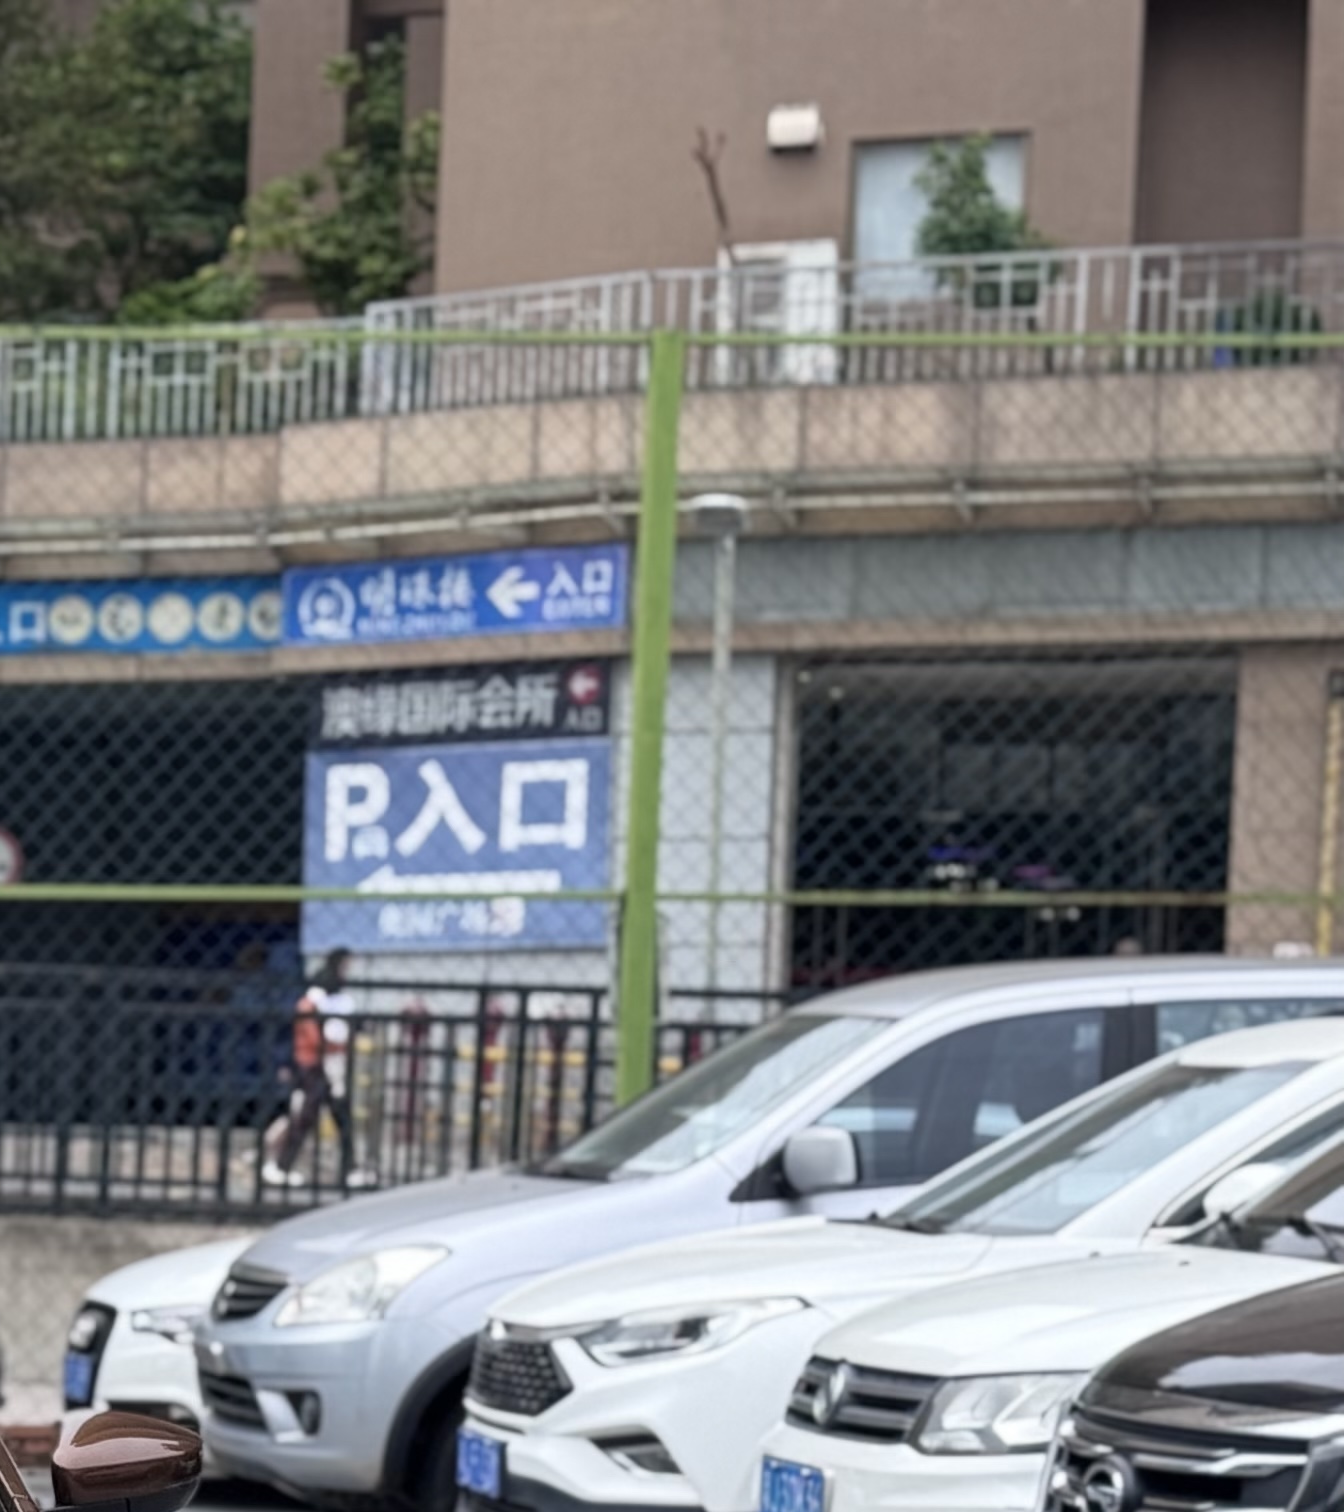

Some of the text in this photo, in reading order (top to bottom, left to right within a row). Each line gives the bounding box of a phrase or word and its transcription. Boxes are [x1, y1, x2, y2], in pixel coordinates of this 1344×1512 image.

[545, 559, 614, 600] 入口
[324, 757, 591, 863] P 入口
